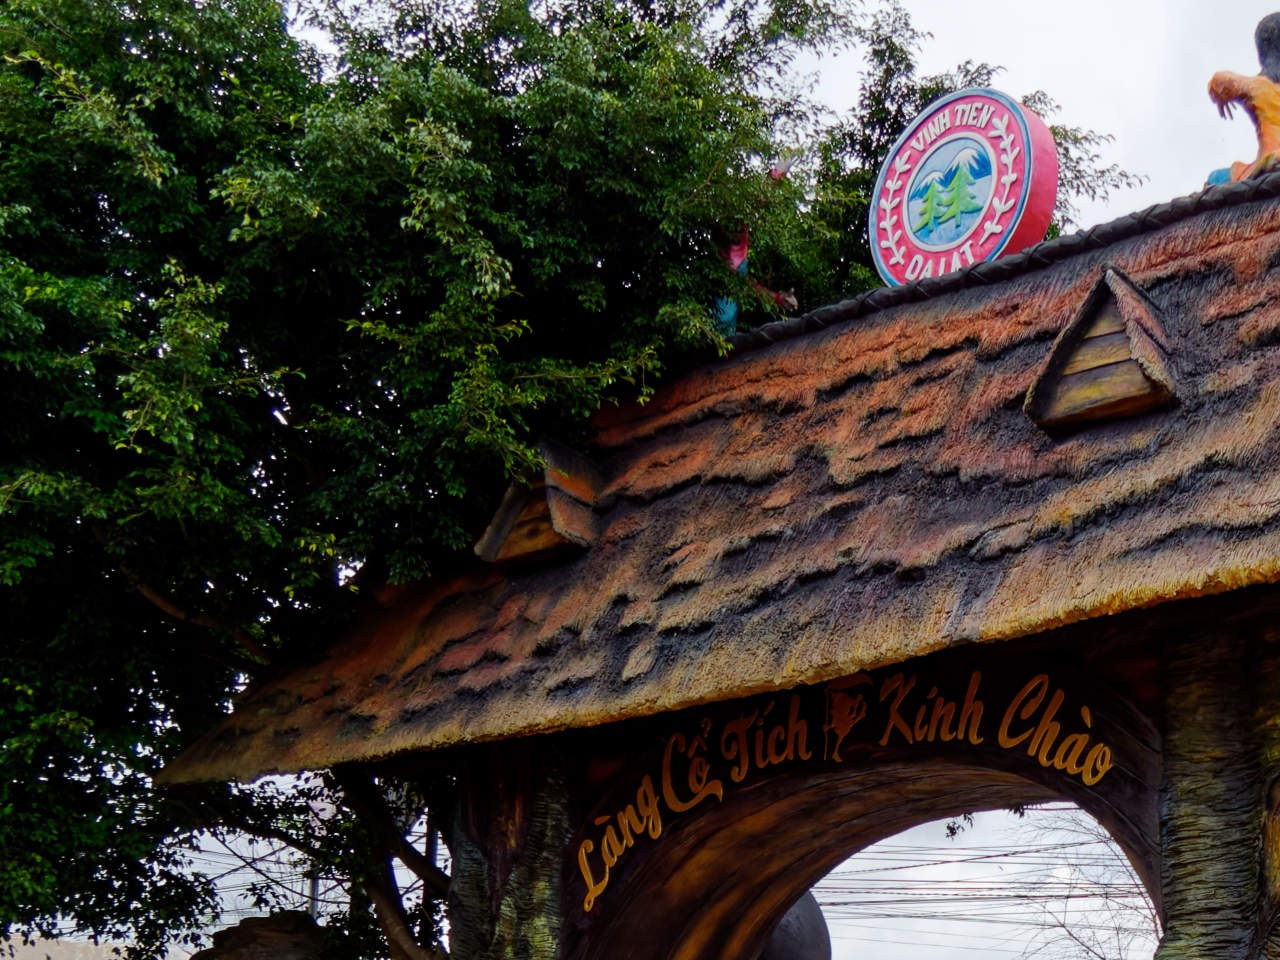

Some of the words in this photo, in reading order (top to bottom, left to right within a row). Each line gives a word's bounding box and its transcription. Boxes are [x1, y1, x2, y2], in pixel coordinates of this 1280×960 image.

[910, 109, 950, 151] VINH
[955, 102, 995, 129] TIEN
[578, 774, 662, 912] Làng
[662, 718, 724, 813] Cổ
[721, 695, 813, 782] Tích
[879, 670, 984, 747] Kính
[998, 673, 1114, 786] Chào
